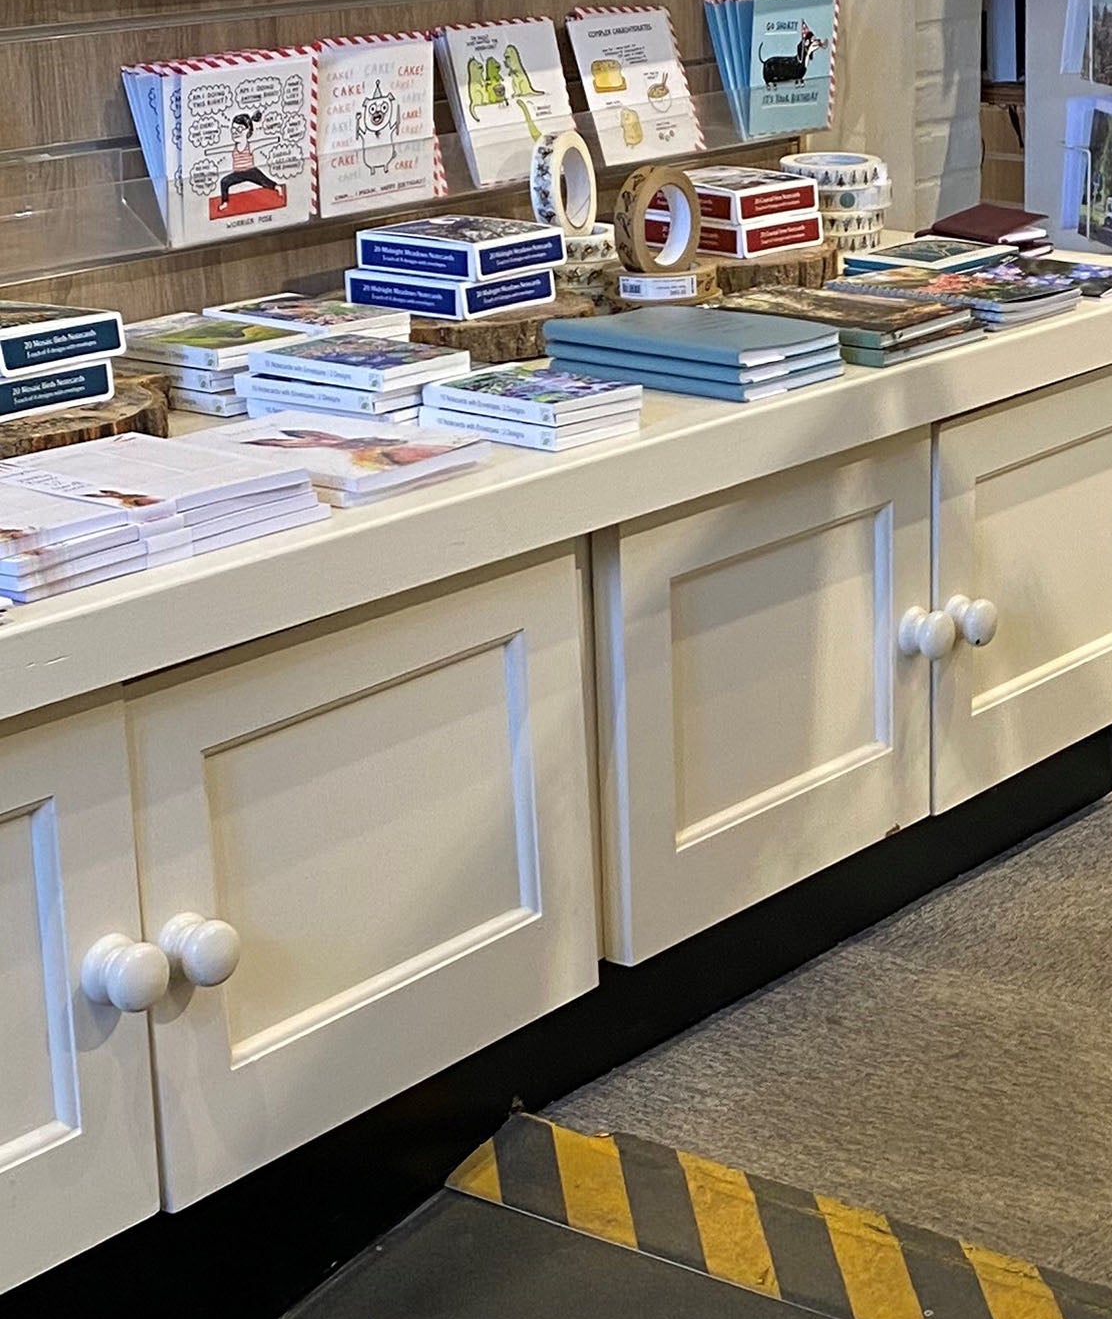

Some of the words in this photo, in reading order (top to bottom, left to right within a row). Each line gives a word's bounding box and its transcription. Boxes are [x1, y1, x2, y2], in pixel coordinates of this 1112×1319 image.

[776, 21, 798, 31] SHORTY
[397, 65, 424, 77] CAKE!
[333, 82, 365, 98] CAKE!
[402, 106, 422, 121] CAKE!
[331, 152, 359, 168] CAKE!
[395, 157, 418, 170] CAKE!
